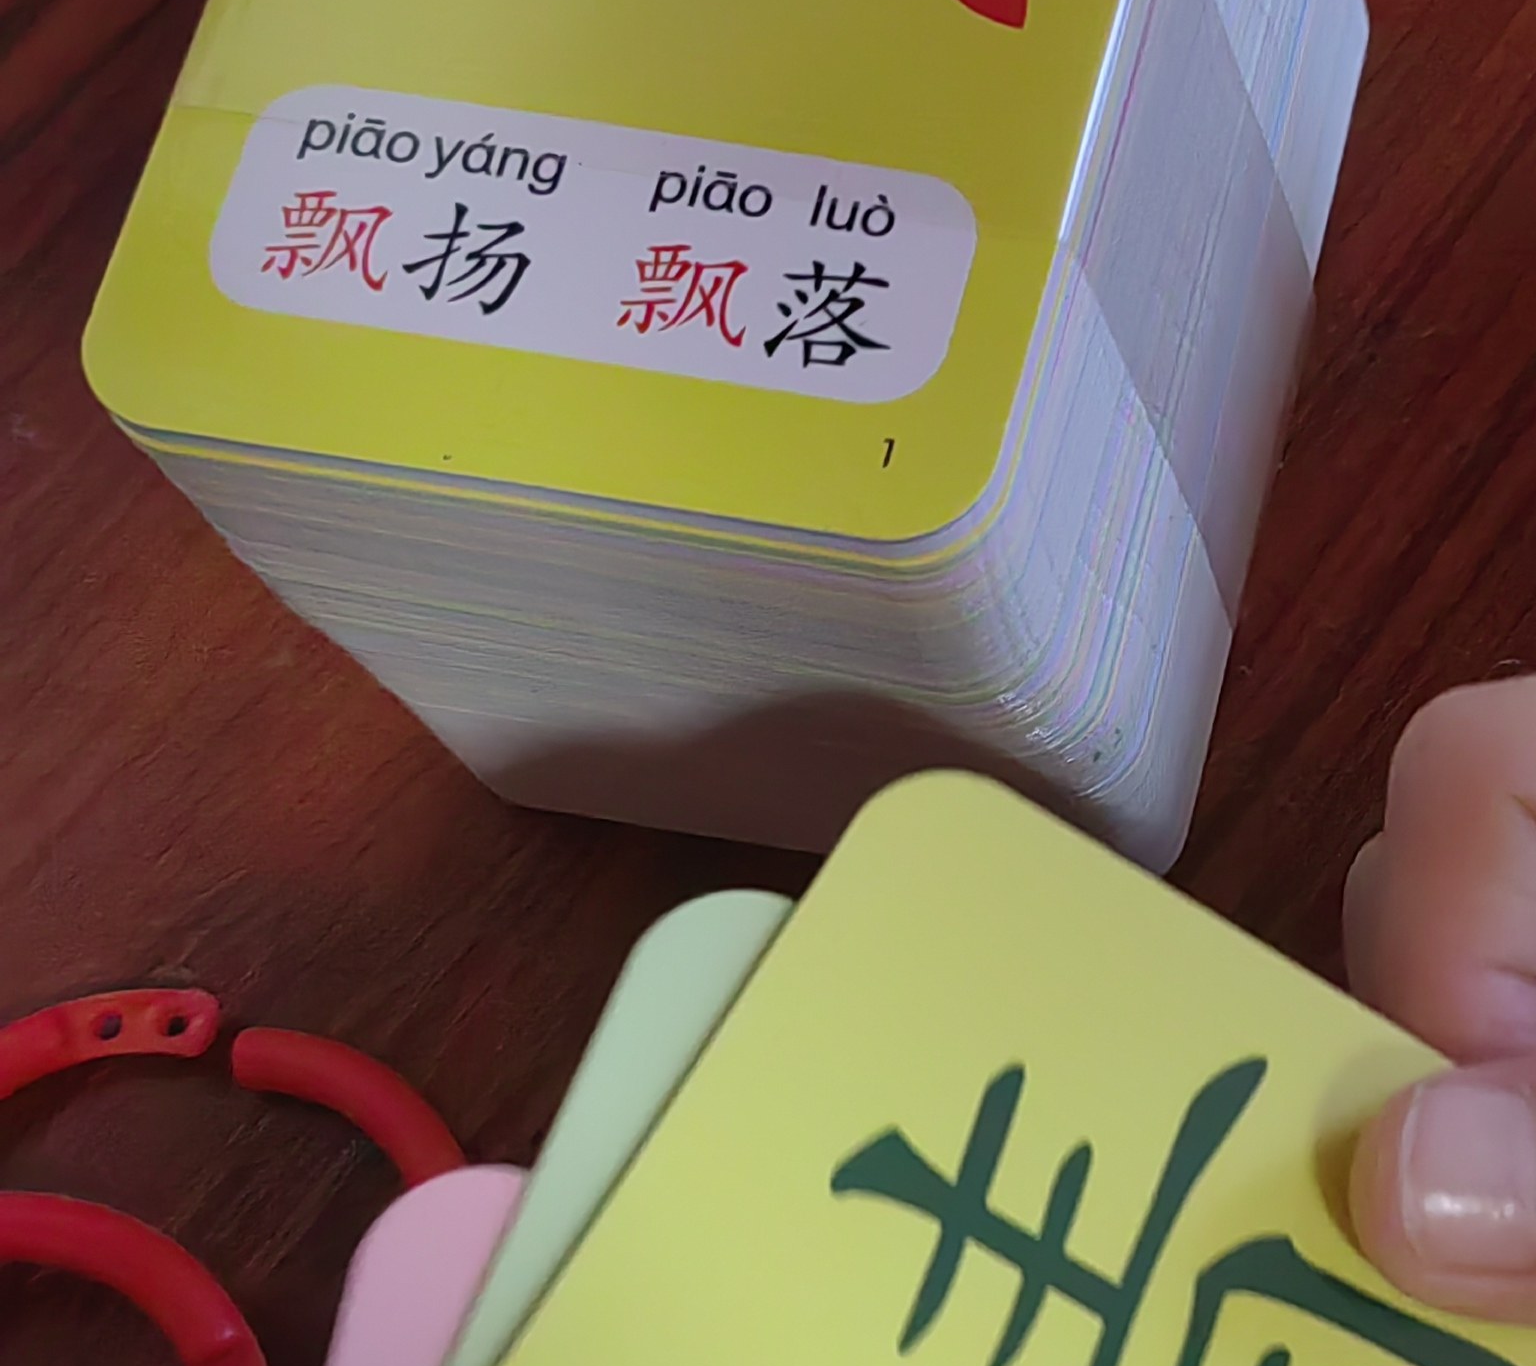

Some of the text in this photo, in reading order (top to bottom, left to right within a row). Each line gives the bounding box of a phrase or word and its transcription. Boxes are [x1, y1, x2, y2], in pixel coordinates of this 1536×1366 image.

[296, 113, 896, 239] piāo yáng piāo luò
[260, 190, 891, 369] 飘扬 飘落
[880, 437, 896, 469] 1
